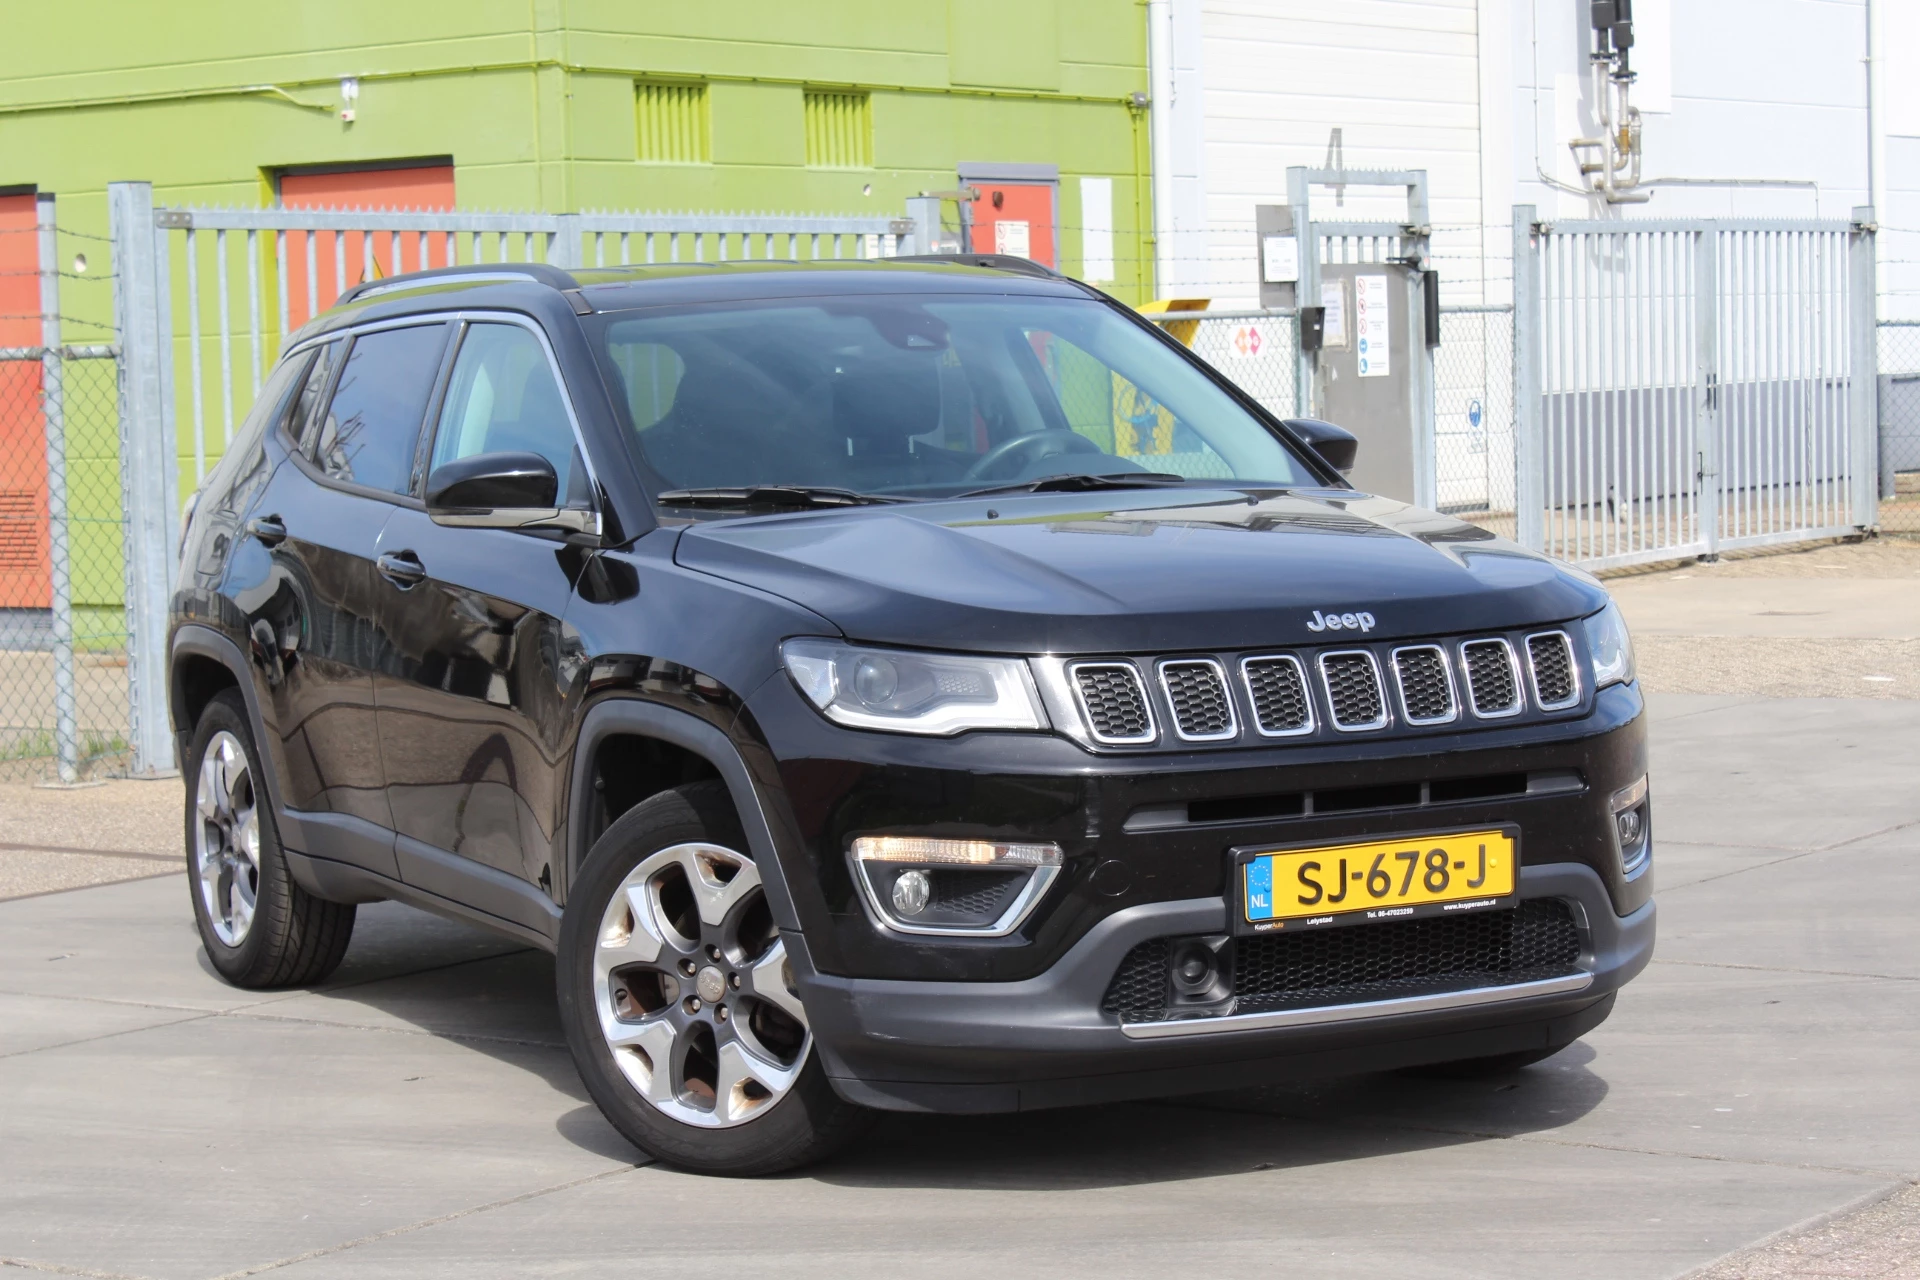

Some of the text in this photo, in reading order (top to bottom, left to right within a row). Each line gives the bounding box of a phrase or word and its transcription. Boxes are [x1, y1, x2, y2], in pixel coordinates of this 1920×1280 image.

[1306, 610, 1376, 633] Jeep
[1297, 843, 1487, 905] SJ-678-J
[1250, 893, 1269, 909] NL
[1443, 899, 1496, 911] www.kuyperauto.nl
[1306, 916, 1333, 925] Lelystad
[1366, 911, 1377, 919] Tel.
